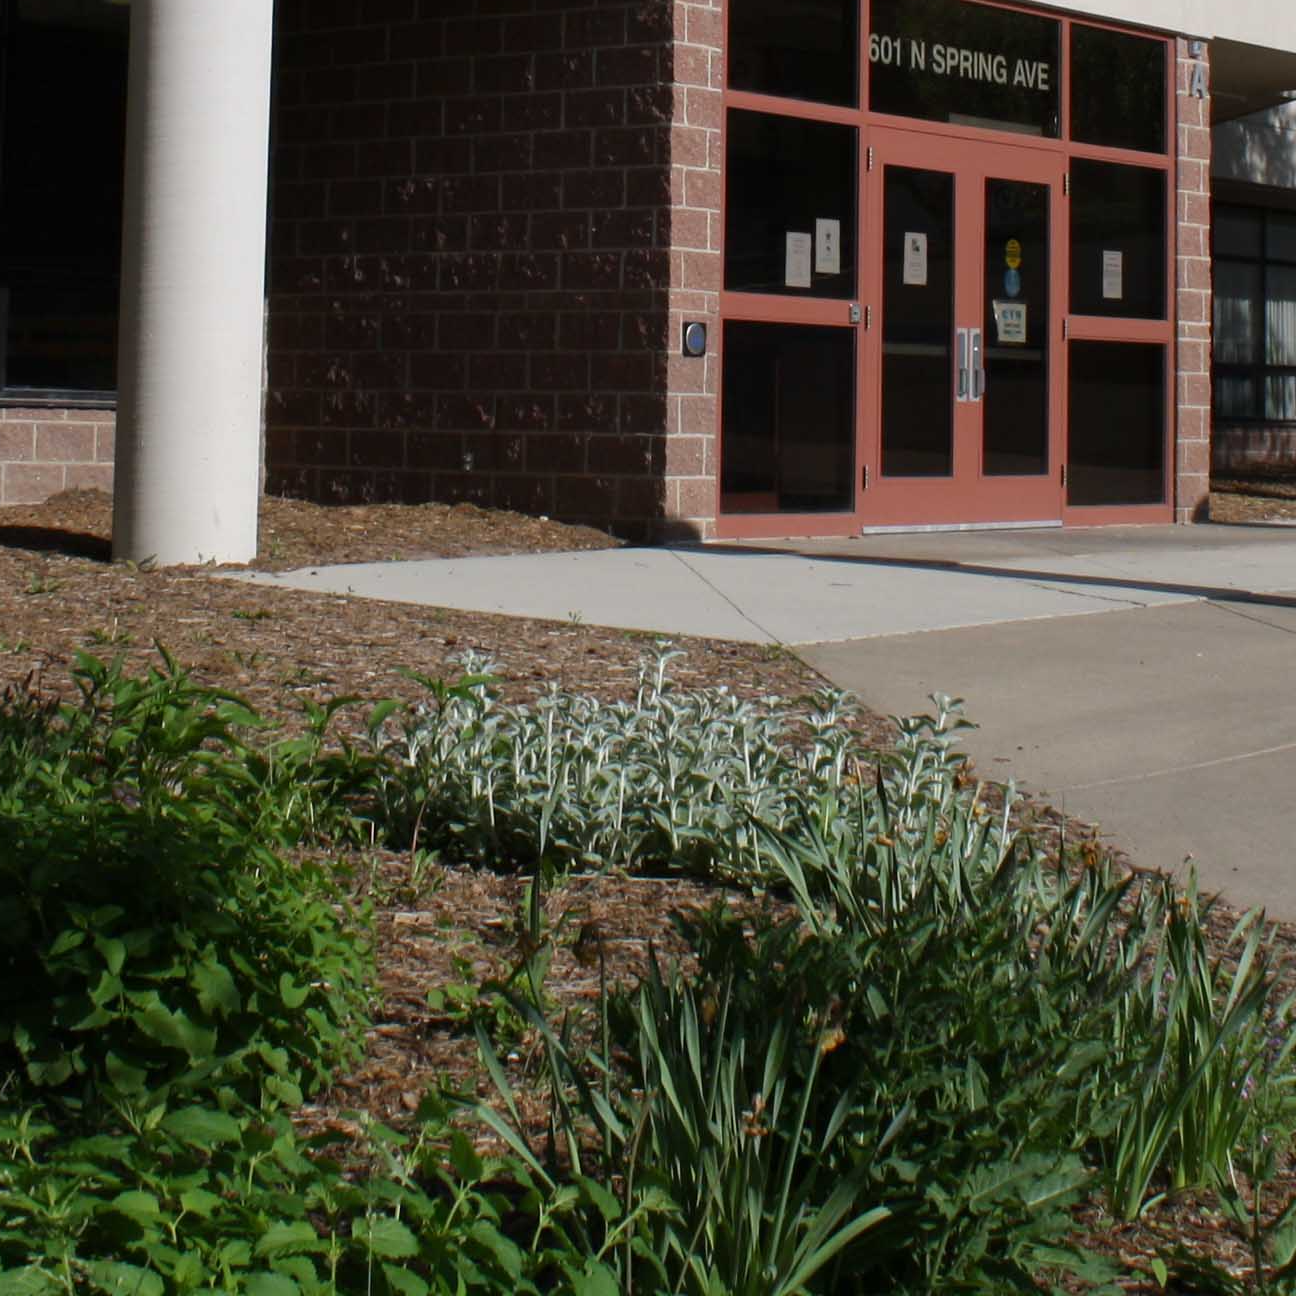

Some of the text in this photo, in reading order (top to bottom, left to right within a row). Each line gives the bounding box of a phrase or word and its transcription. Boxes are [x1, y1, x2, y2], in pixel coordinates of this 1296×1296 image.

[869, 33, 1050, 91] 601 N SPRING AVE
